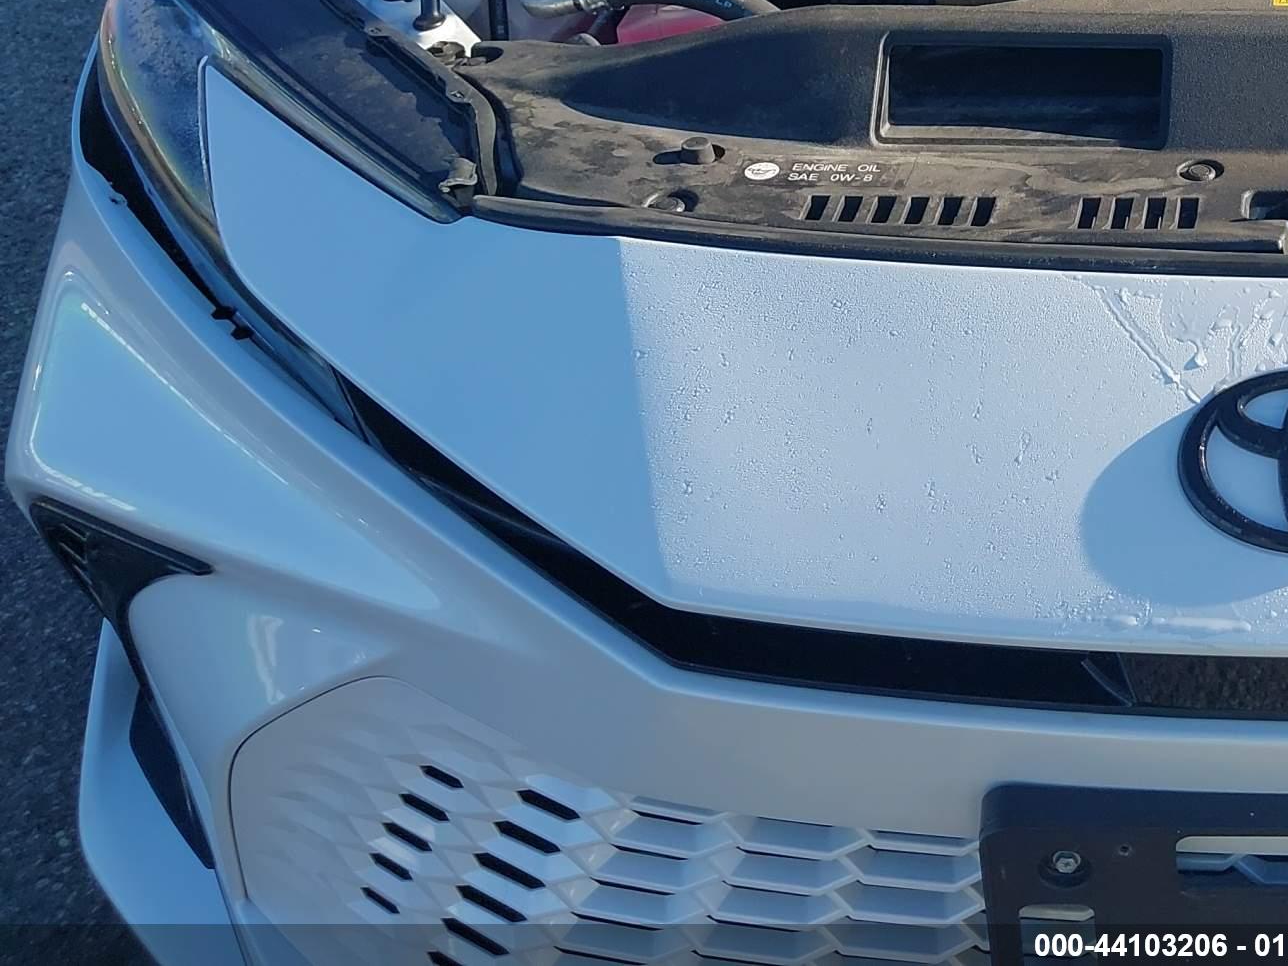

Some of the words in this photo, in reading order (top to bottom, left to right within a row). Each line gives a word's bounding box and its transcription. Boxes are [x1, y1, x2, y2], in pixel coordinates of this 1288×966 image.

[792, 163, 848, 172] ENGINE
[857, 164, 881, 173] OIL
[788, 173, 819, 181] SAE
